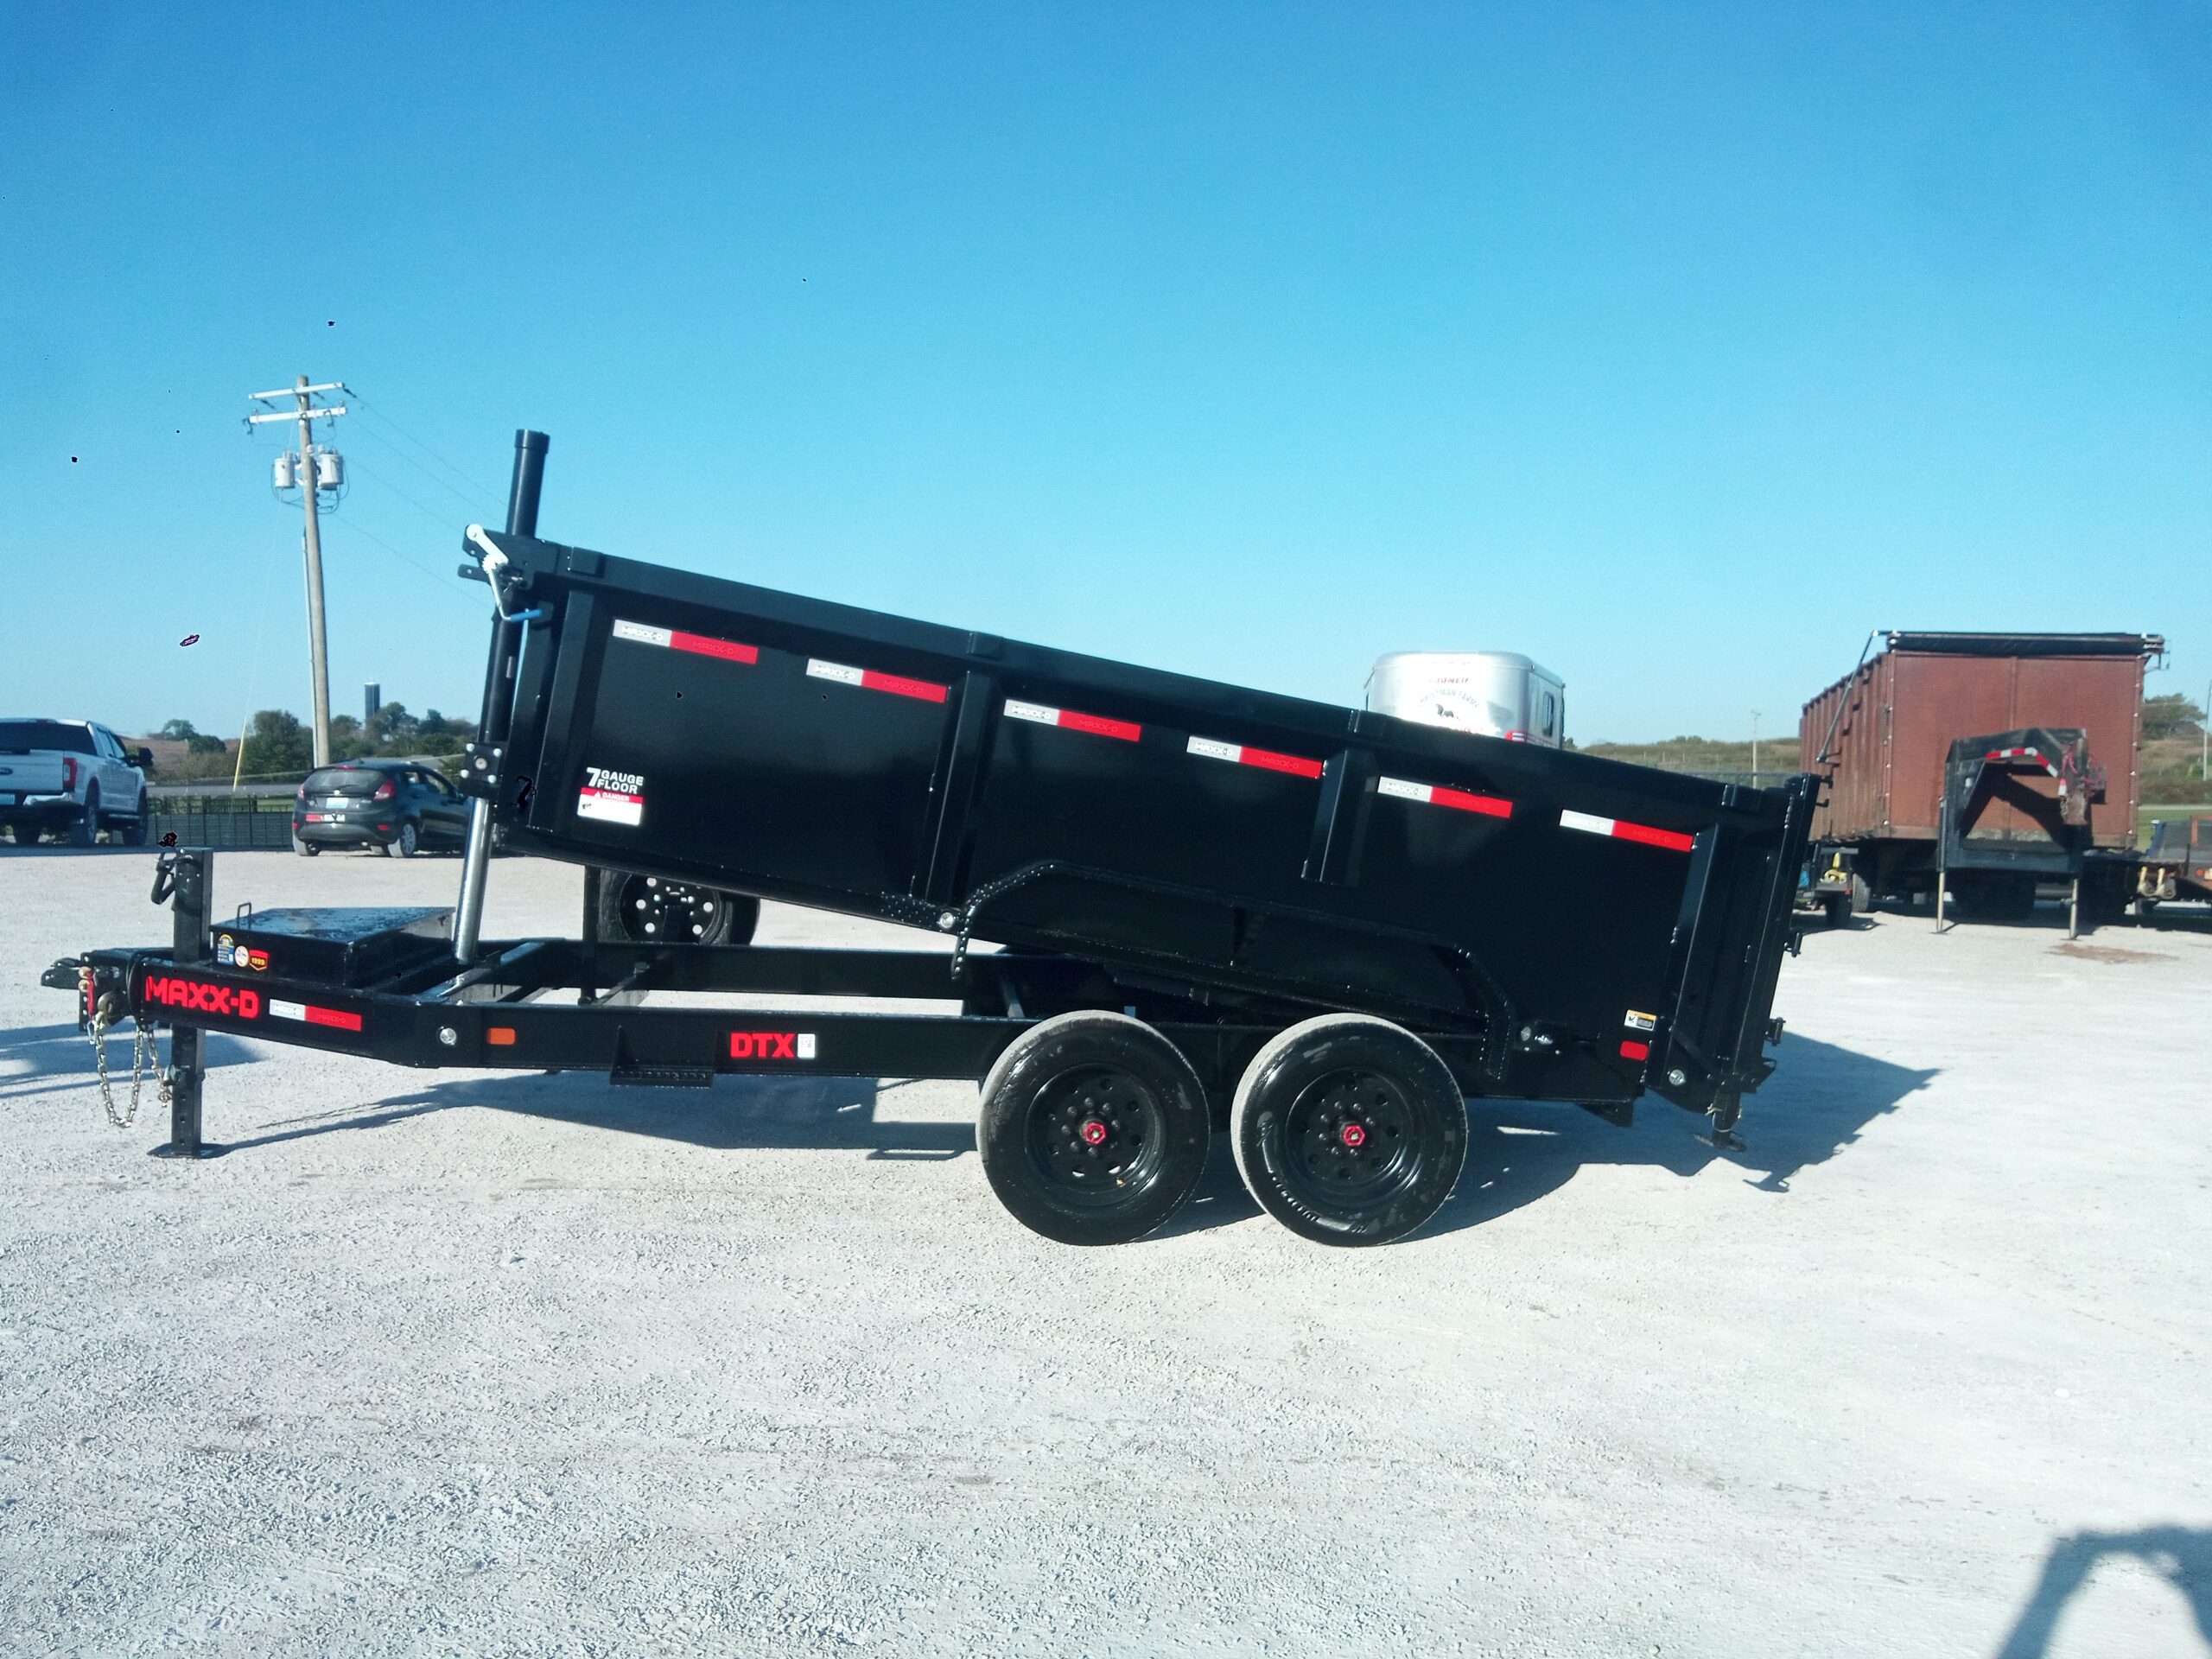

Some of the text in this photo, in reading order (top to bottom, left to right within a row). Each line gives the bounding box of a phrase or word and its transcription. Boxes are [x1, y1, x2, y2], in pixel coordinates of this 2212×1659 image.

[621, 626, 664, 641] MAXX-D
[693, 641, 734, 655] MAXX-D
[815, 665, 855, 680] MAXX-D
[883, 680, 924, 694] MAXX-D
[1012, 705, 1052, 720] MAXX-D
[1079, 719, 1118, 733] MAXX-D
[1195, 742, 1234, 757] MAXX-D
[1260, 756, 1300, 770] MAXX-D
[587, 766, 644, 787] 7 GAUGE
[597, 779, 638, 794] FLOOR
[602, 791, 630, 802] DANGER
[146, 976, 258, 1018] MAXX-D
[730, 1033, 795, 1058] DTX
